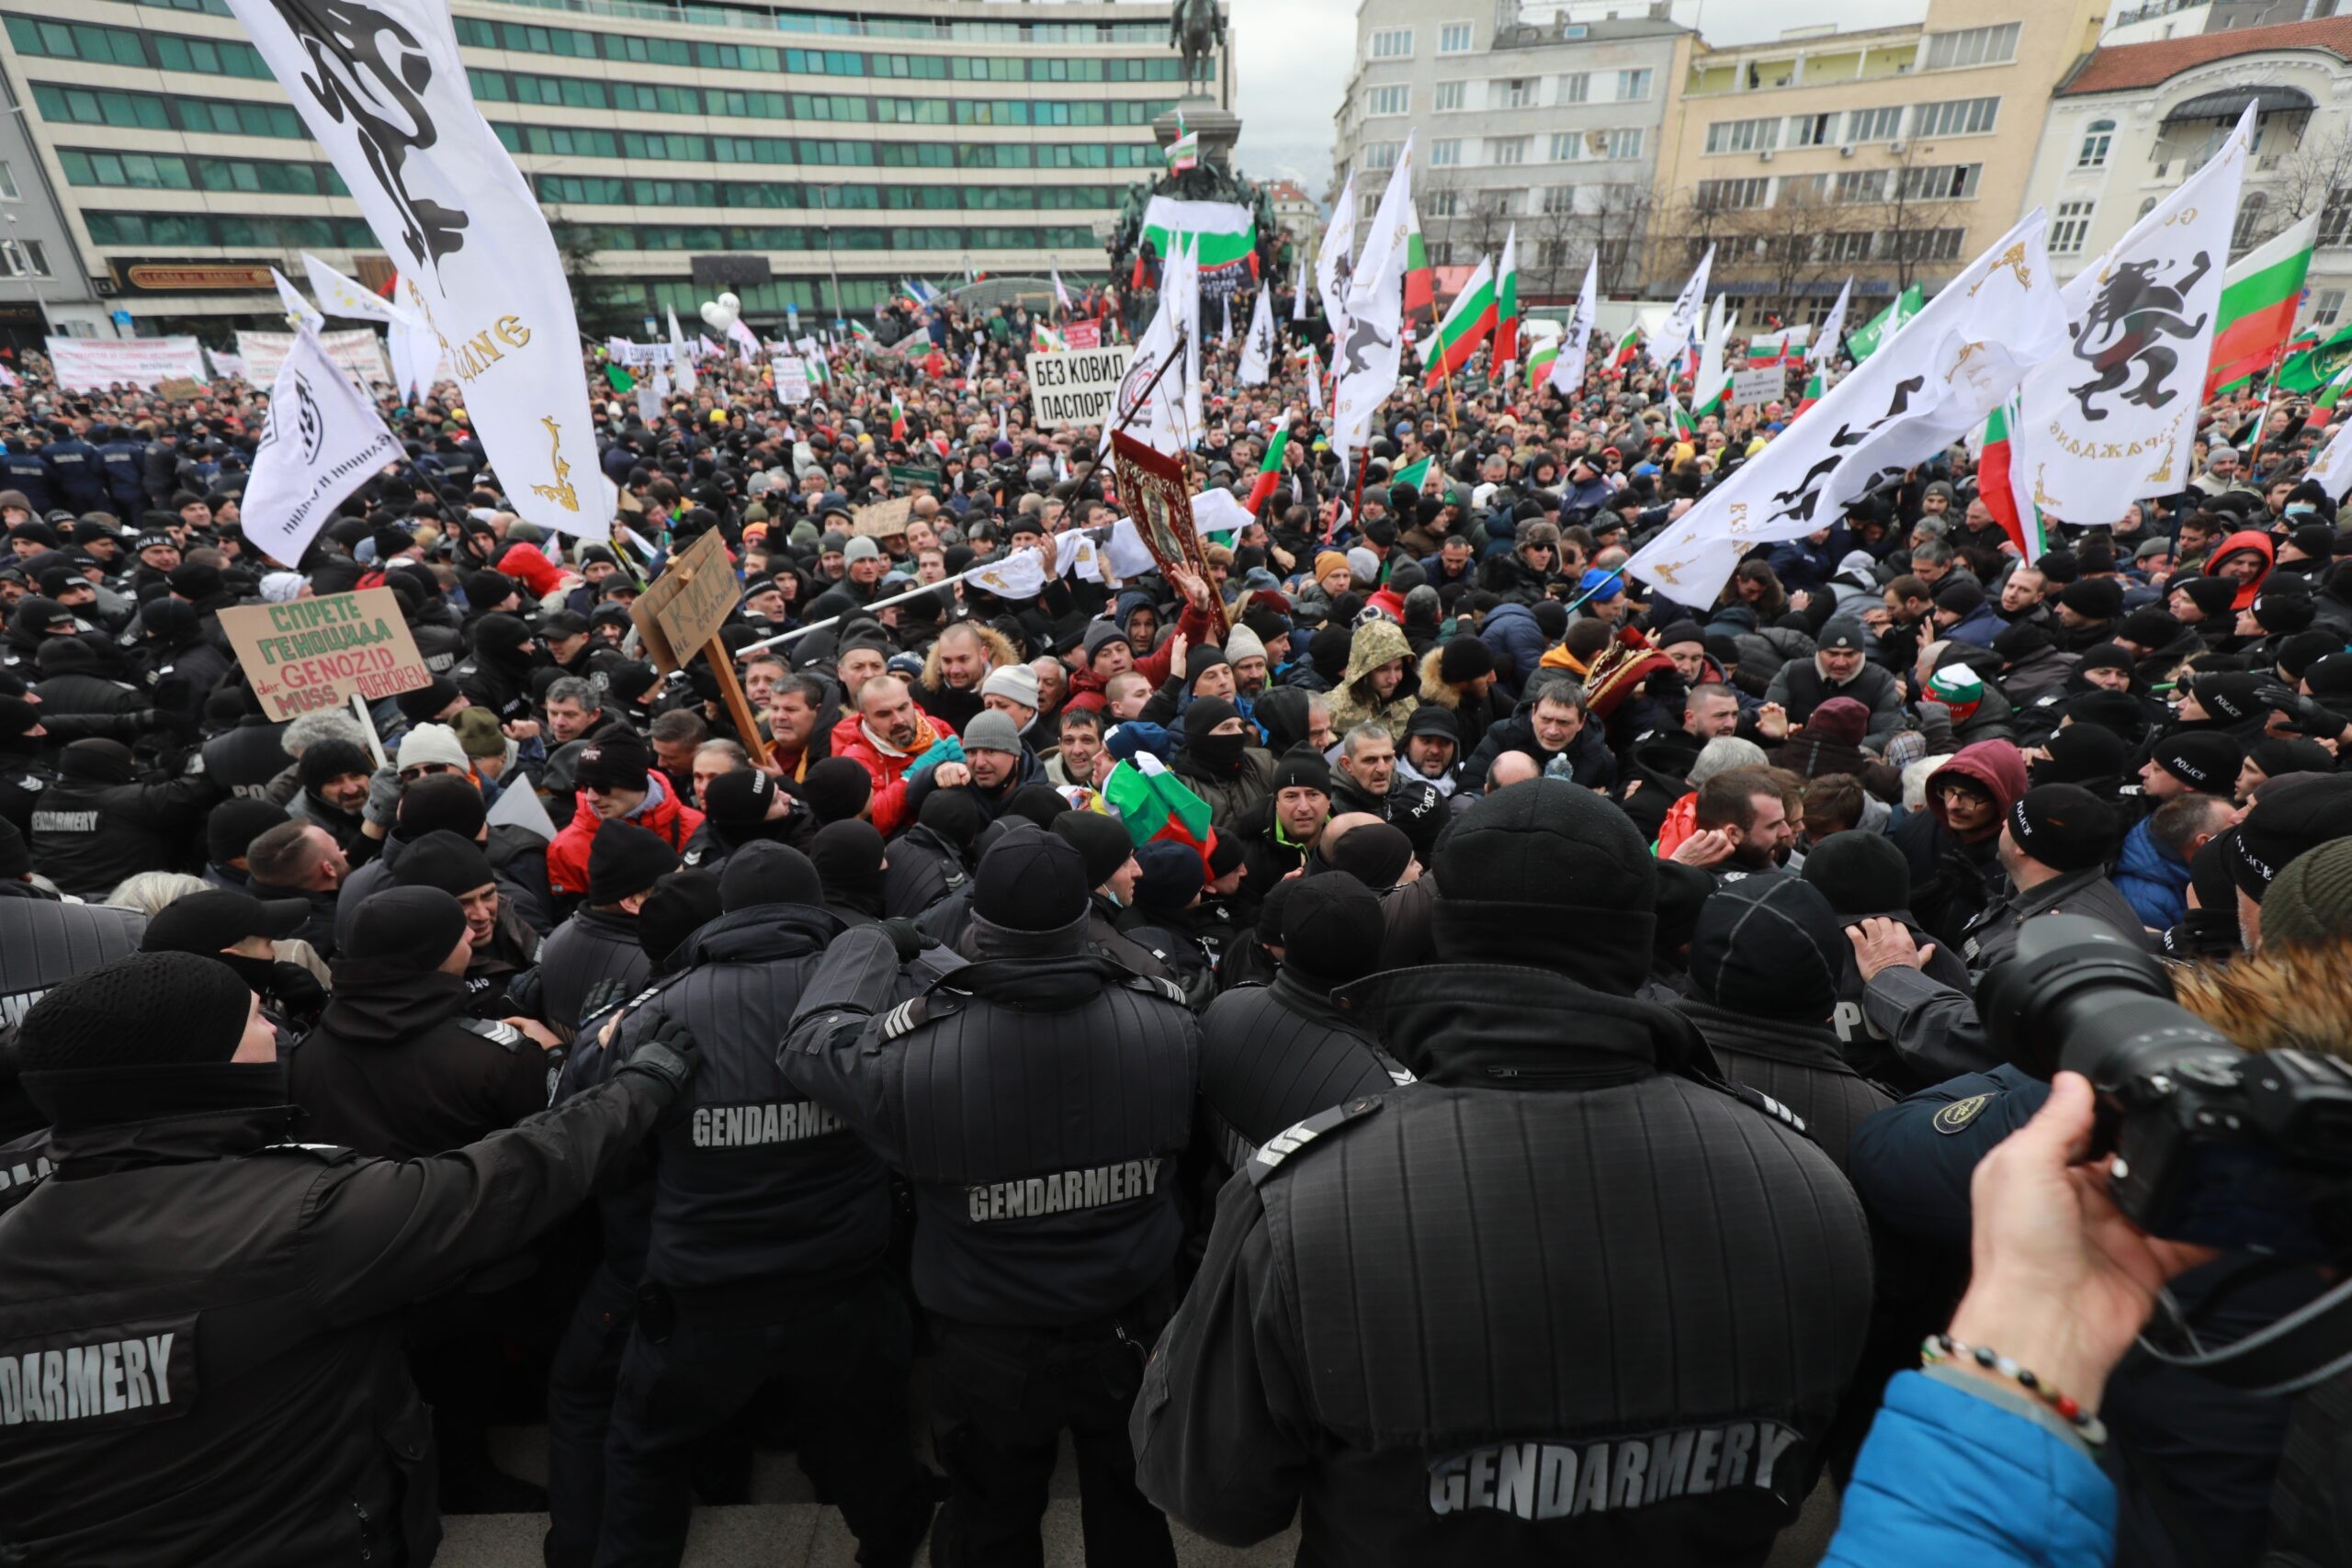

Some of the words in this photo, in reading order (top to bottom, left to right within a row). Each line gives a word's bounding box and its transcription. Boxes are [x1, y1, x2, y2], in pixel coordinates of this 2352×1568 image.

[1035, 359, 1066, 387] БЕЗ
[1069, 355, 1125, 384] КОВИД
[1041, 390, 1116, 421] ПАСПОРТ
[268, 594, 362, 632] СПРЕТЕ
[256, 618, 394, 665] ГЕНОЦИДА
[257, 680, 280, 696] der
[280, 647, 395, 689] GENOZID
[273, 684, 339, 717] MUSS
[2214, 694, 2242, 717] POLICE
[2173, 757, 2207, 781] POLICE
[1411, 786, 1436, 818] POLICE
[693, 1101, 851, 1147] GENDARME
[968, 1158, 1161, 1223] GENDARMERY
[0, 1333, 175, 1426] DARMERY
[1429, 1422, 1792, 1521] GENDARMERY
